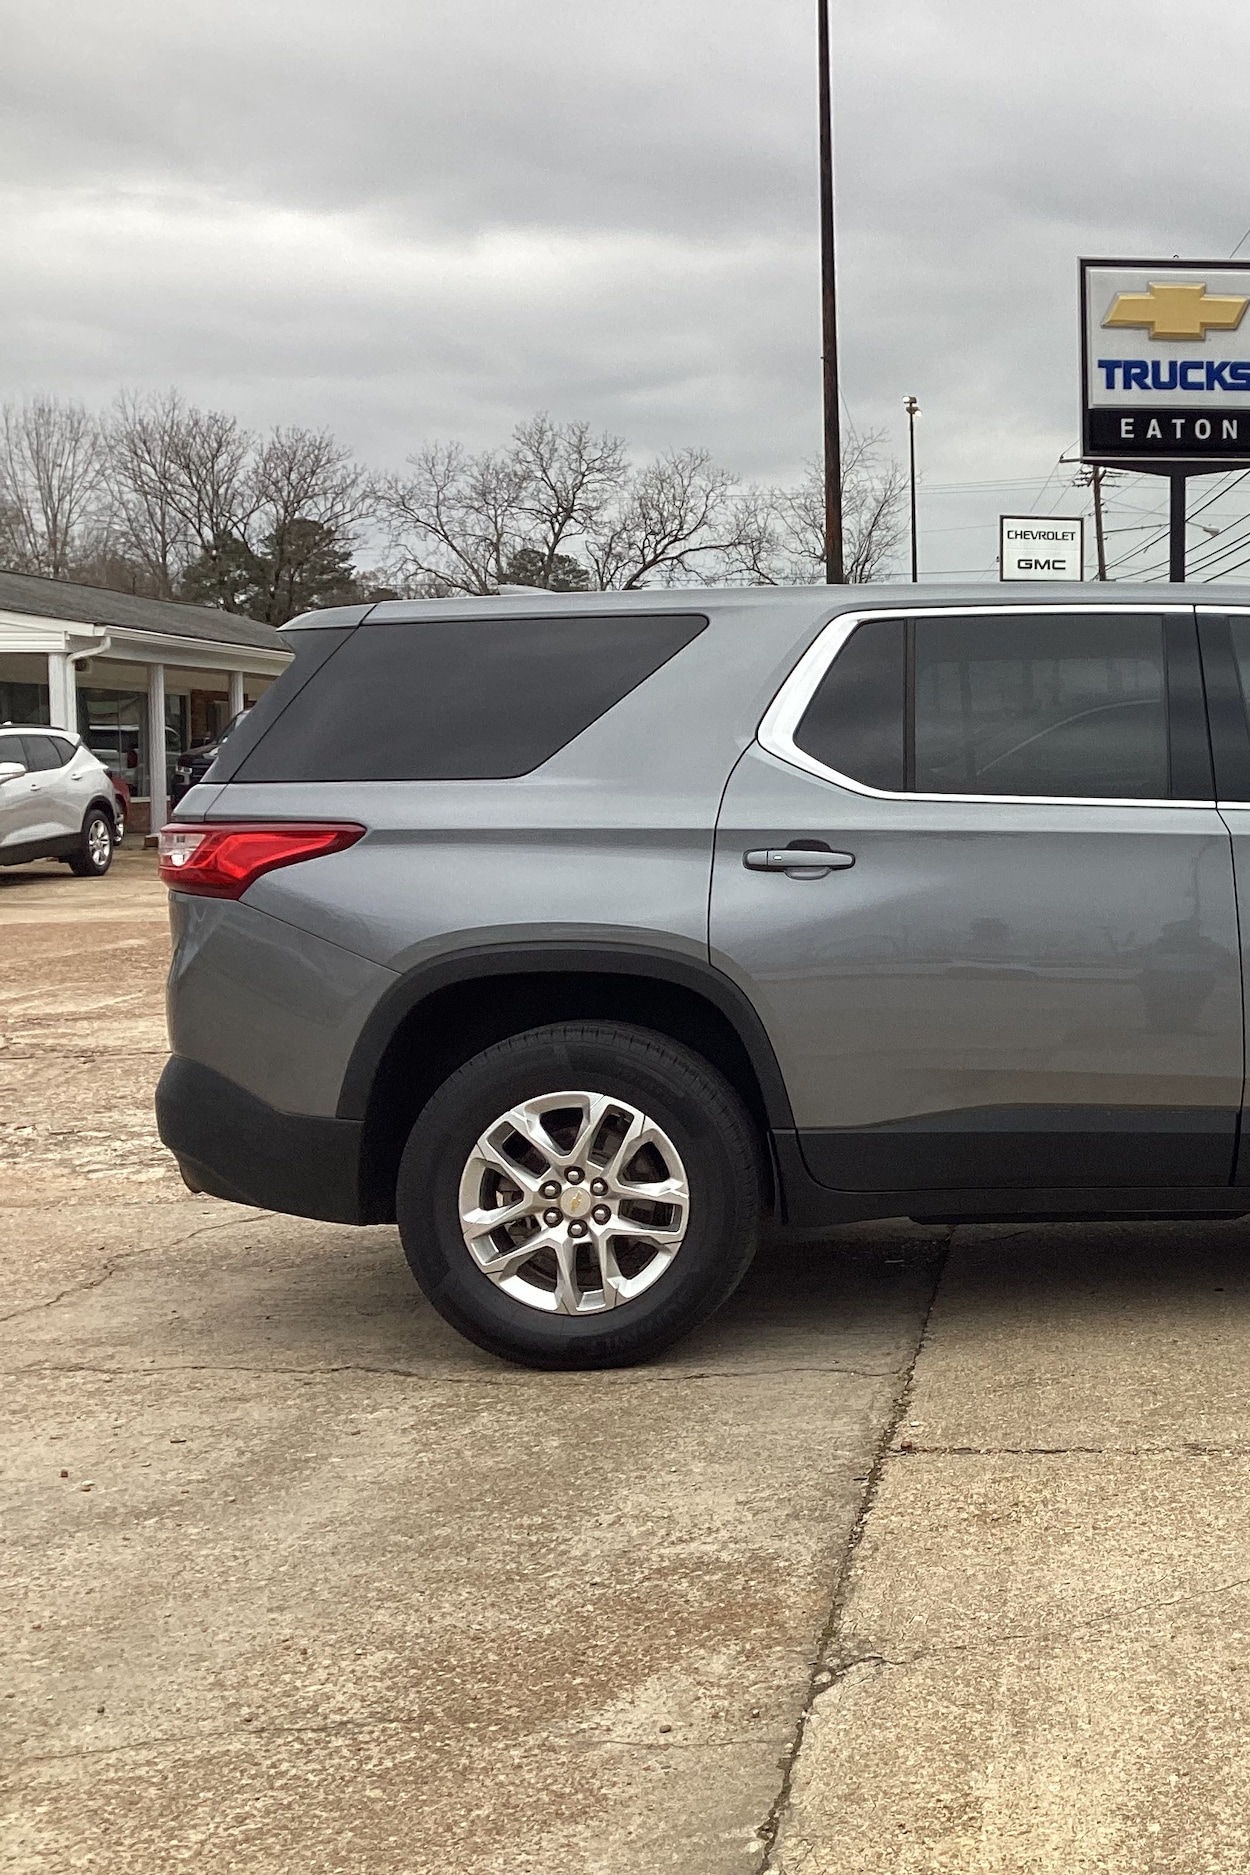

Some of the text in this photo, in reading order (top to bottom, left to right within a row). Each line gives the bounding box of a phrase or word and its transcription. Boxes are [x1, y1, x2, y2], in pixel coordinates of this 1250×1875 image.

[1120, 418, 1238, 440] EATON
[1007, 529, 1077, 541] CHEVROLET
[1017, 558, 1067, 571] GMC
